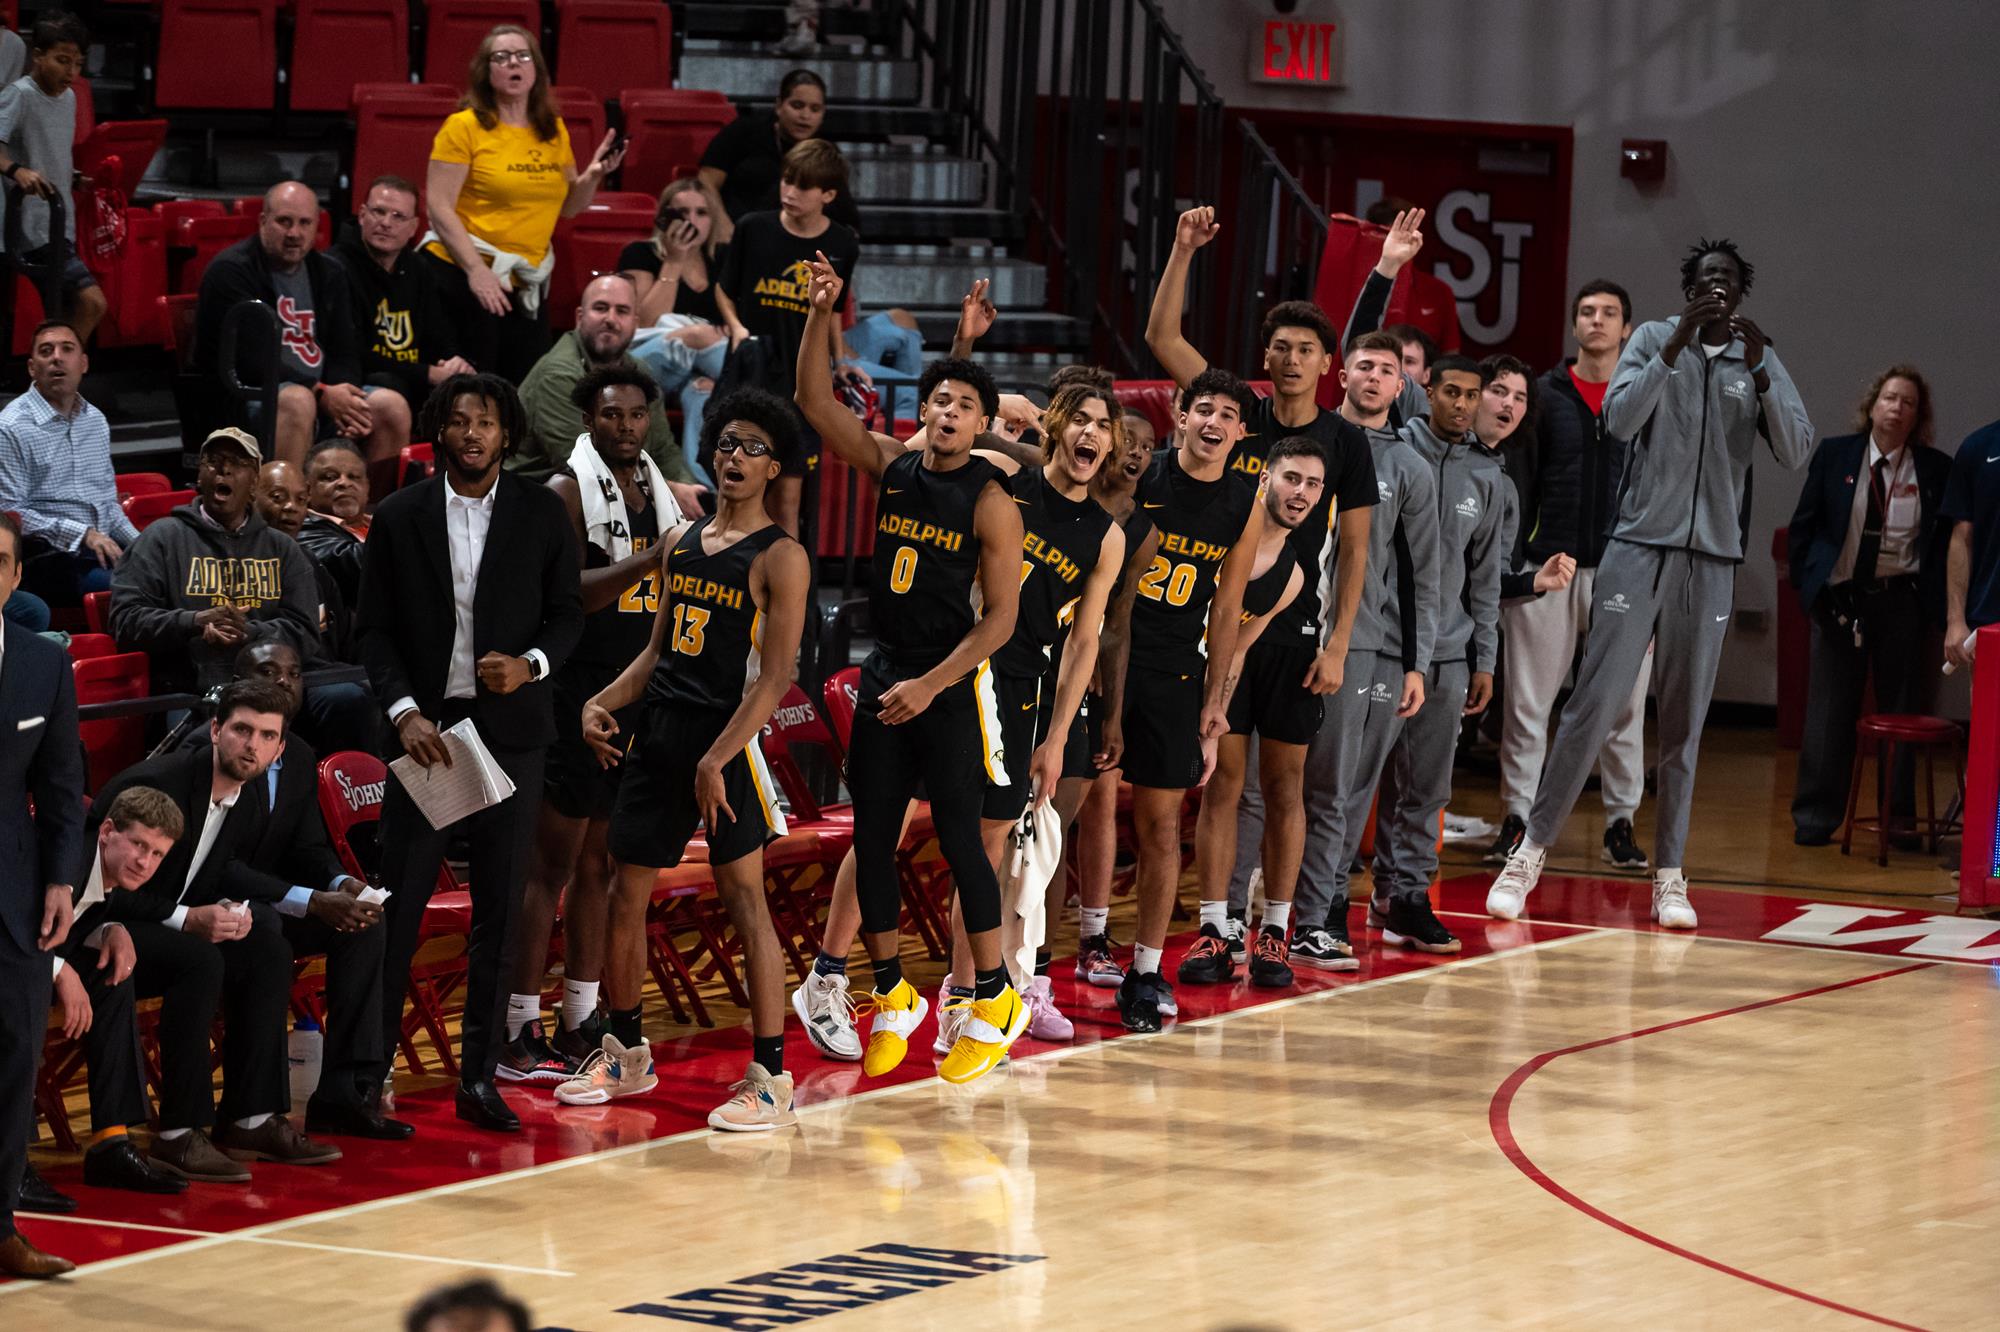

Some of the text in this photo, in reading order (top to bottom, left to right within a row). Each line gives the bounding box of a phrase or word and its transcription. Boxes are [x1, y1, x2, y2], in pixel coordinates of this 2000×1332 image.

[1264, 21, 1336, 81] EXIT
[879, 512, 964, 553] ADELPHI
[1023, 530, 1081, 584] ELPHI
[669, 572, 745, 610] DELPHI
[890, 545, 919, 595] 0
[1137, 554, 1198, 607] 20
[671, 603, 712, 657] 13
[611, 1242, 1050, 1332] ARENA
